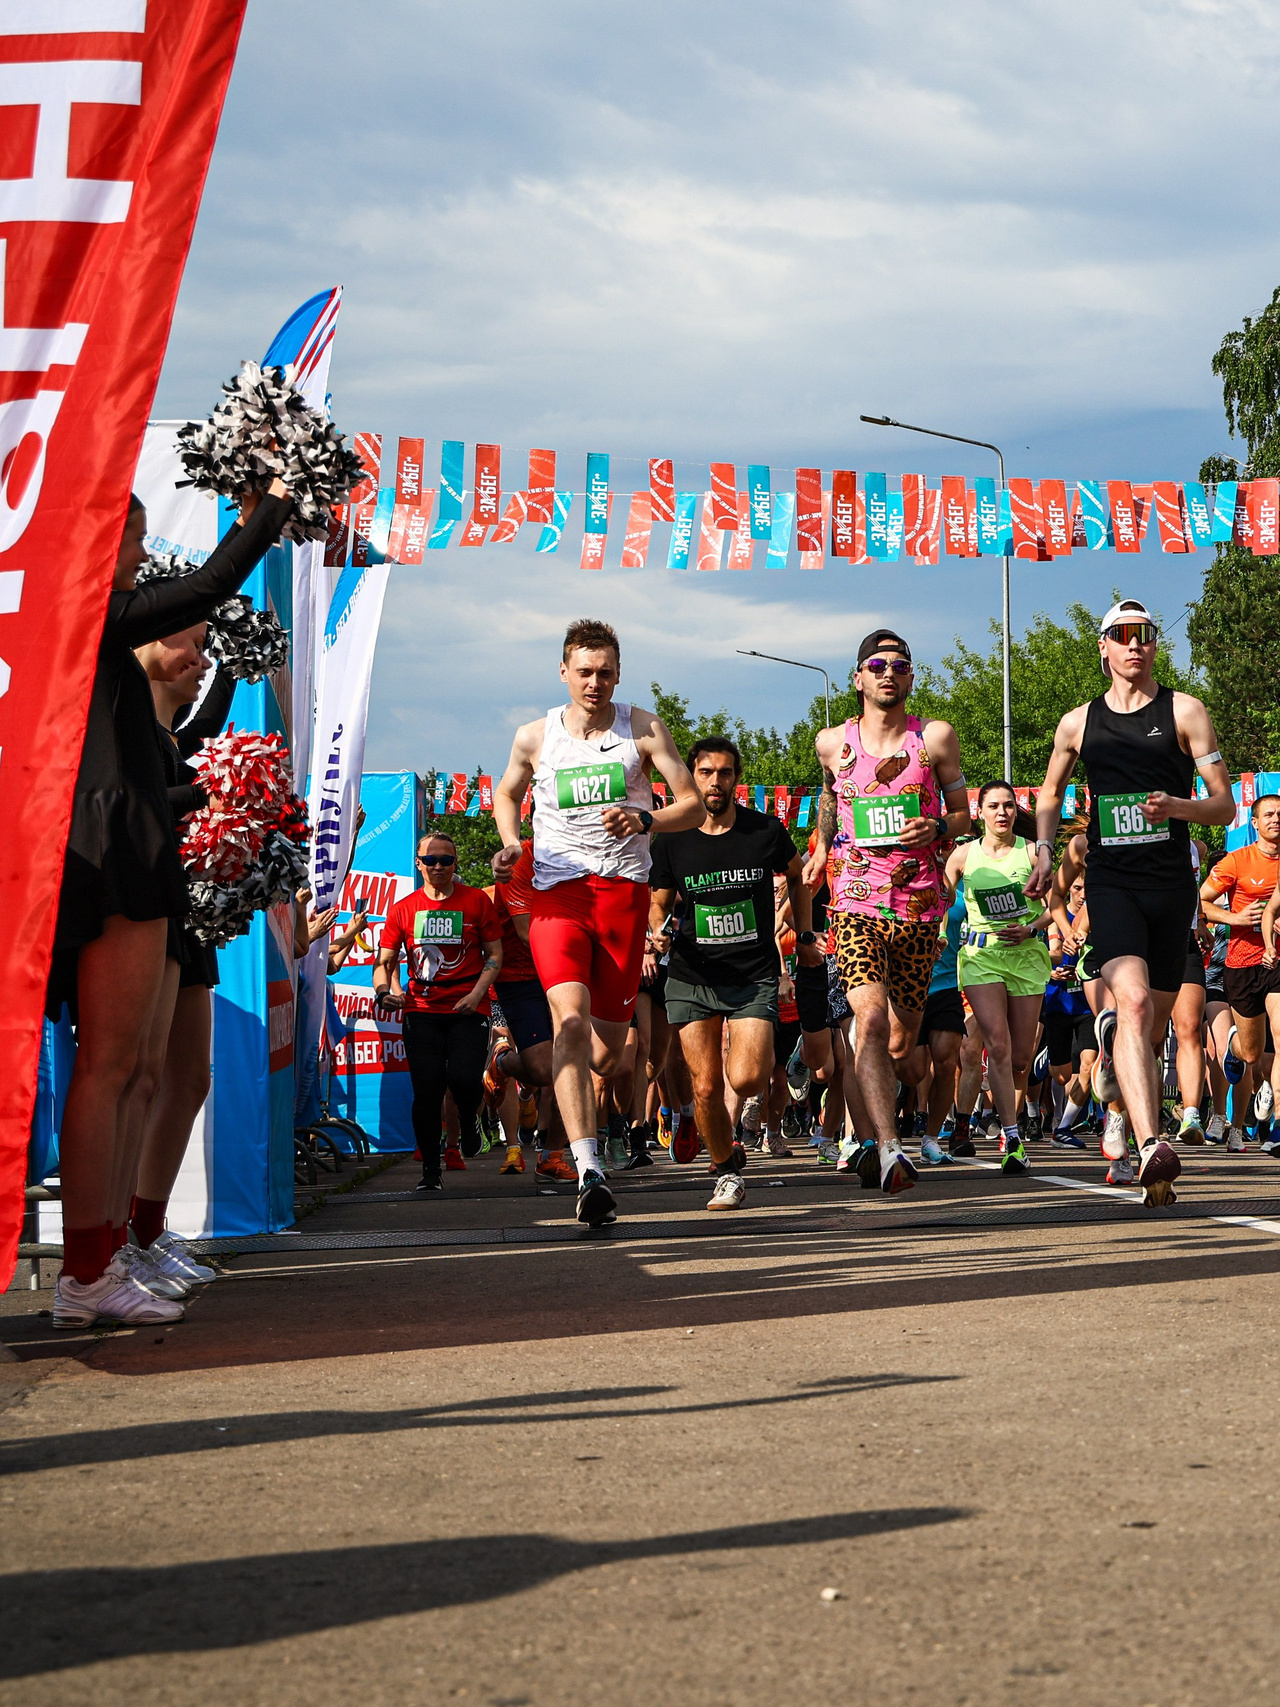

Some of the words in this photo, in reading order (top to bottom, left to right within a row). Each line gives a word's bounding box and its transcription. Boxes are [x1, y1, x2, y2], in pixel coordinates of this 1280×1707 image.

[401, 460, 420, 496] ЗАБЕГ
[478, 472, 497, 514] ЗАБЕГ
[591, 479, 608, 519] ЗАБЕГ
[753, 489, 771, 527] ЗАБЕГ
[405, 513, 426, 554] ЗАБЕГ
[673, 515, 693, 556] ЗАБЕГ
[836, 499, 853, 544] ЗАБЕГ
[870, 498, 887, 541] ЗАБЕГ
[886, 513, 904, 550] ЗАБЕГ
[947, 503, 966, 543] ЗАБЕГ
[980, 500, 998, 541] ЗАБЕГ
[1048, 504, 1068, 544] ЗАБЕГ
[1115, 505, 1135, 543] ЗАБЕГ
[1191, 501, 1212, 540] ЗАБЕГ
[1259, 505, 1276, 544] ЗАБЕГ
[569, 774, 611, 804] 1627
[379, 820, 391, 832] ЛЕТ
[392, 794, 412, 822] ЗАРЯЖАЕМ
[866, 805, 905, 836] 1515
[684, 867, 764, 889] PLANTFUELED
[984, 891, 1018, 914] 1609
[422, 917, 453, 937] 1668
[706, 912, 745, 937] 1560
